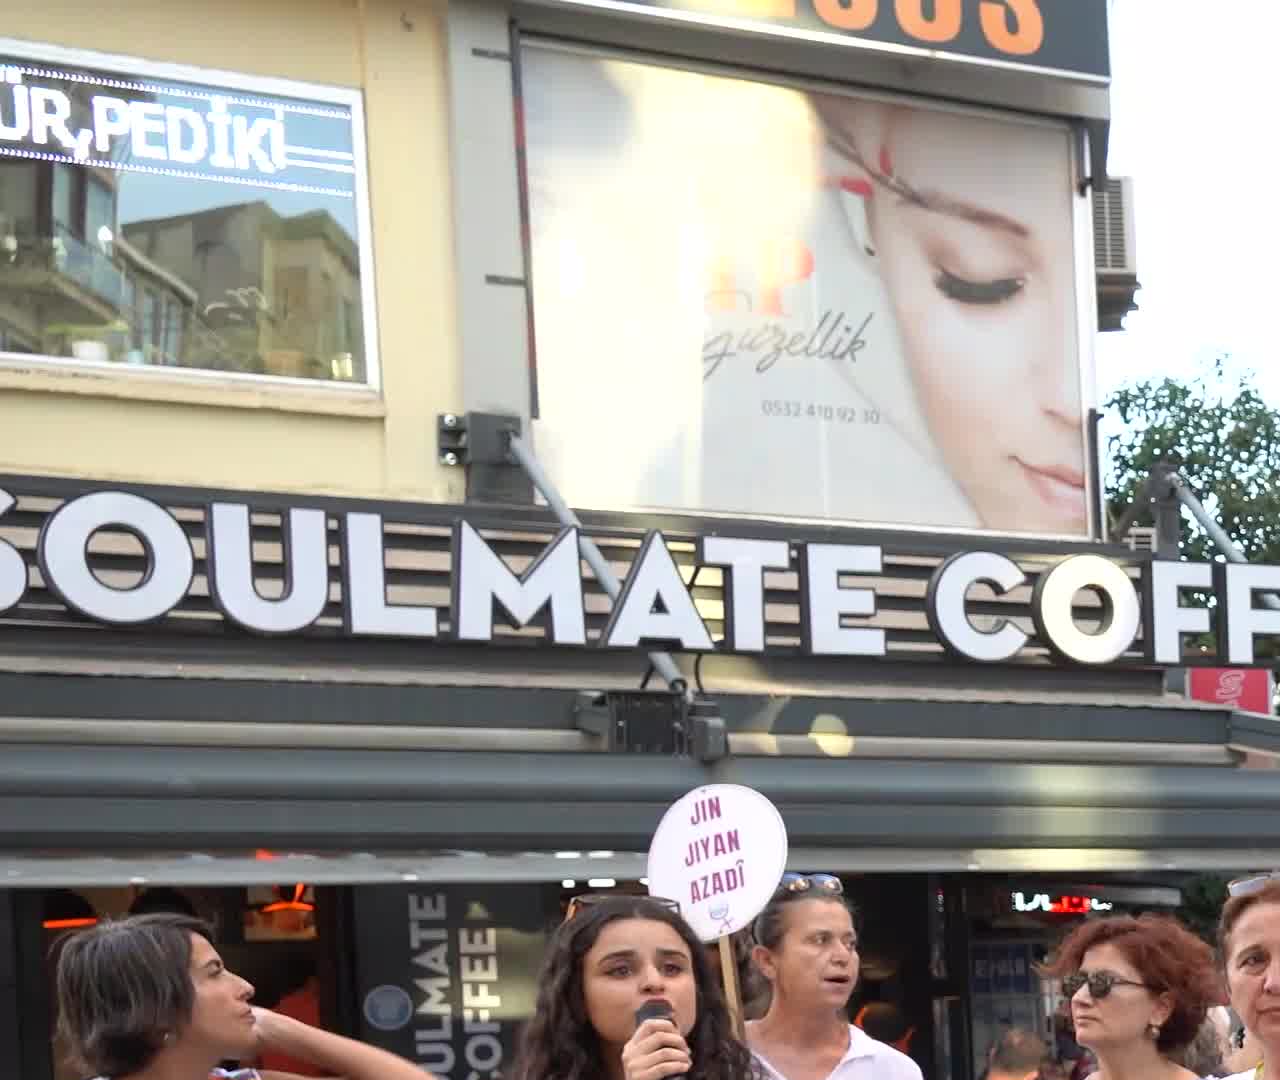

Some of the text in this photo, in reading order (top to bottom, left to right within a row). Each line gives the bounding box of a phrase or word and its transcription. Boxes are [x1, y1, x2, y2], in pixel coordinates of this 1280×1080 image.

[0, 488, 887, 658] OULMATE
[690, 796, 722, 825] JIN
[684, 829, 741, 867] JIYAN
[690, 859, 745, 904] AZADÎ
